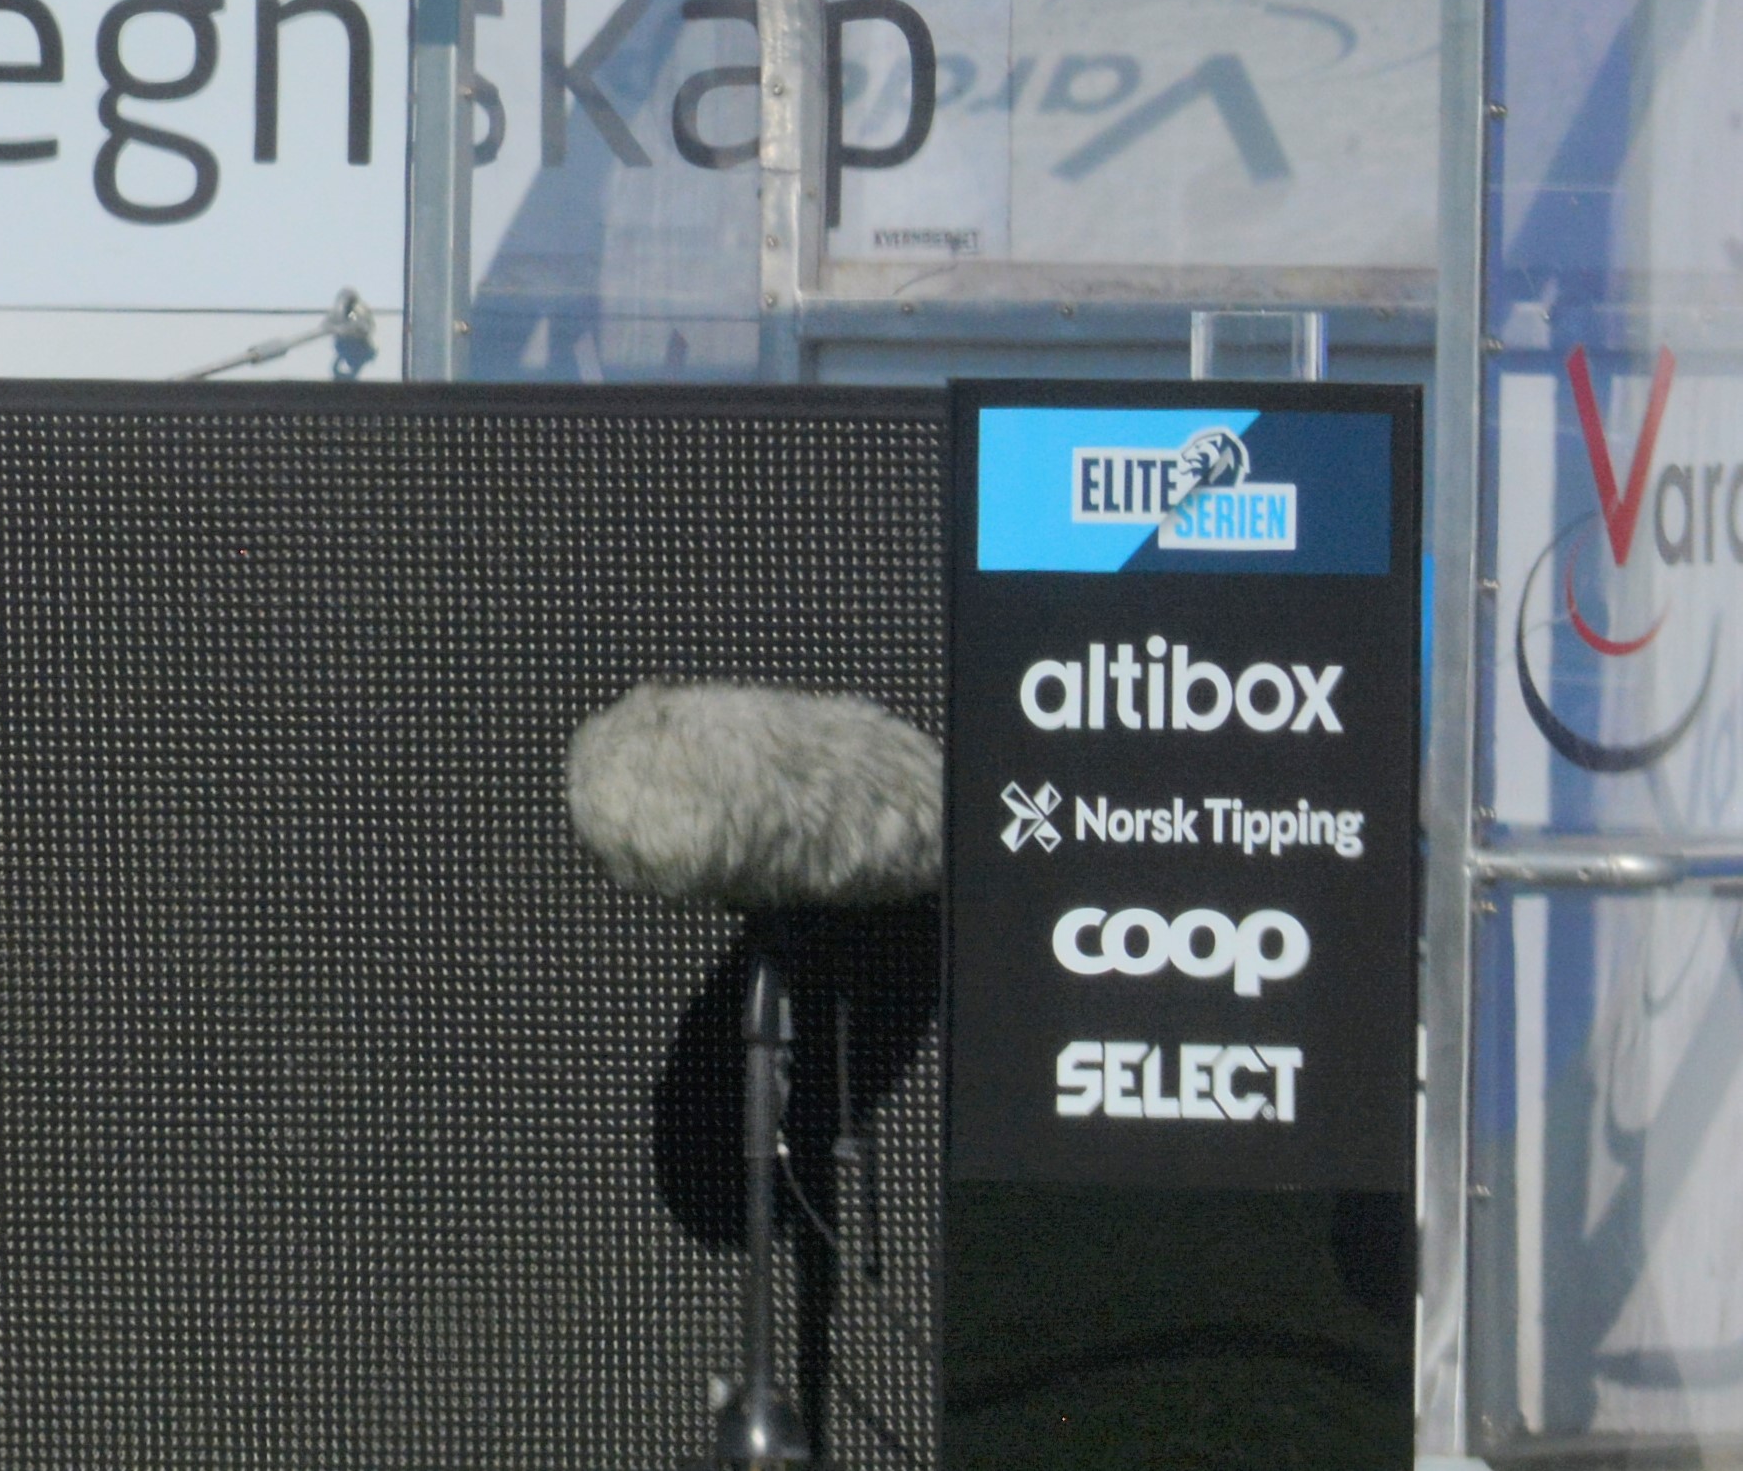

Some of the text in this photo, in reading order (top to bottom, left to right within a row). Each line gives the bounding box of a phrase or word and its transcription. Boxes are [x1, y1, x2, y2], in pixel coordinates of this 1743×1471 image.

[1080, 456, 1179, 514] ELITE
[1174, 492, 1288, 541] SERIEN
[1019, 635, 1346, 733] altibox
[1075, 795, 1365, 859] Norsk Tipping
[1052, 907, 1311, 997] coop
[1055, 1041, 1303, 1122] SELECT
